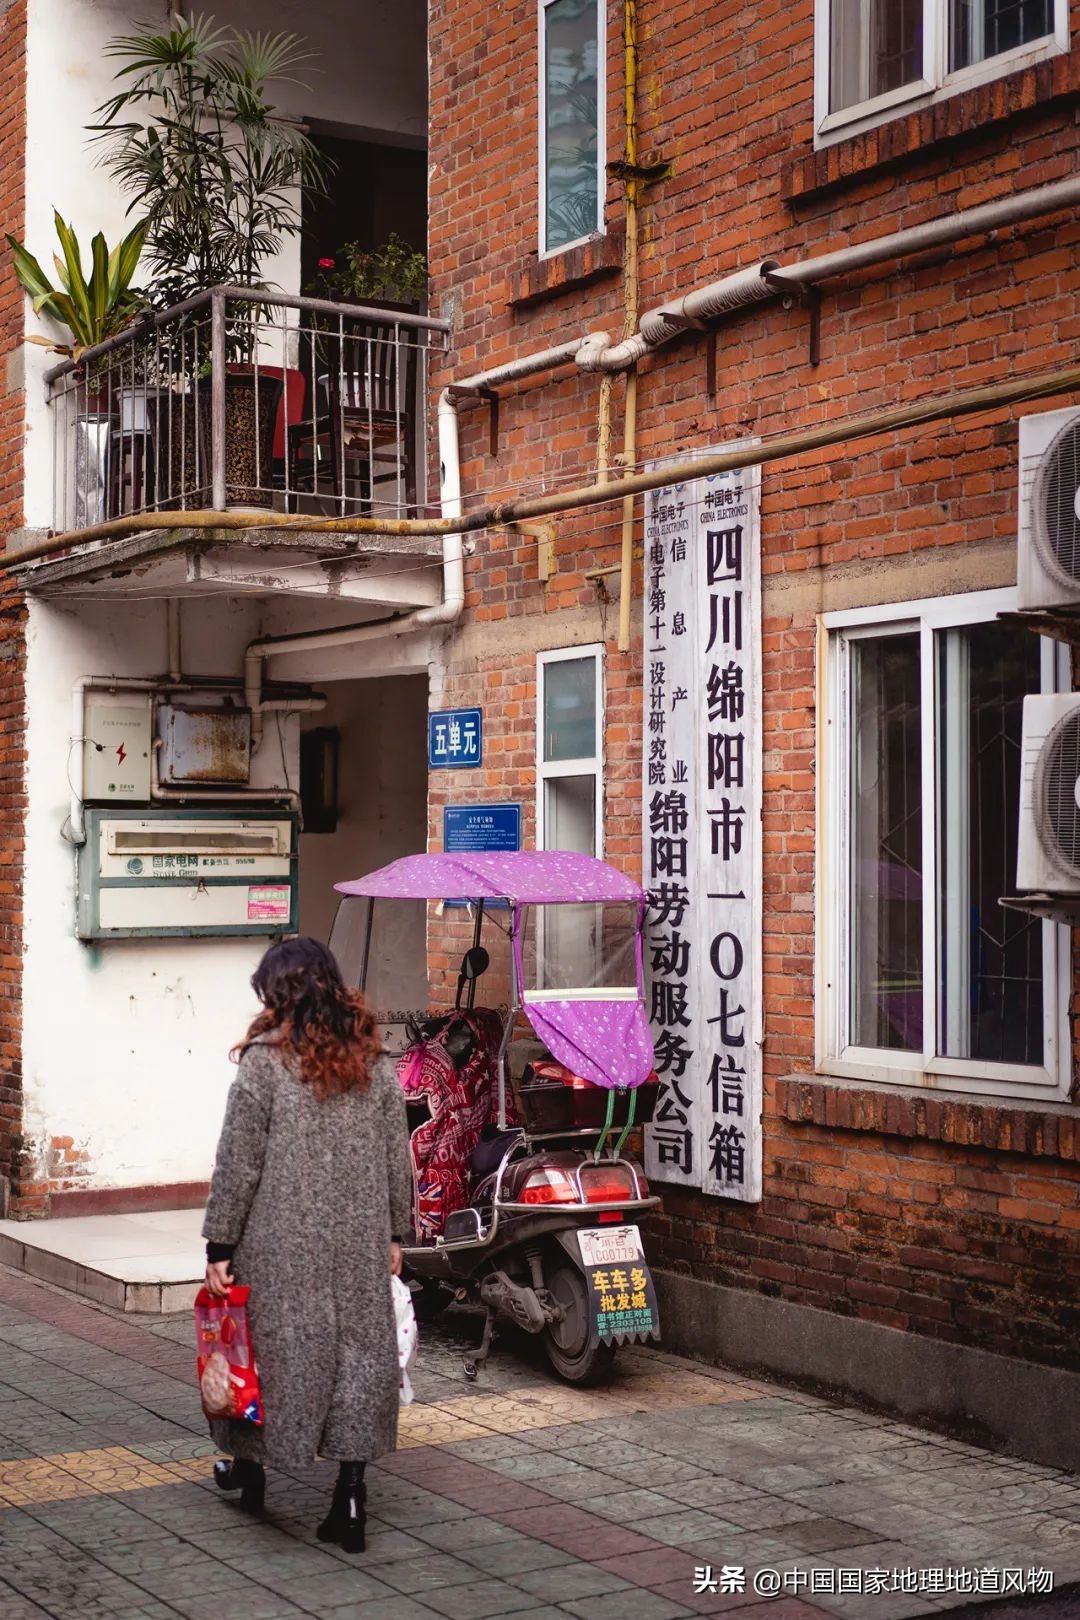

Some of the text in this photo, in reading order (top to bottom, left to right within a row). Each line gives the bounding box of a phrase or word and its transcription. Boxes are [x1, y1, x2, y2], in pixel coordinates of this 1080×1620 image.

[705, 485, 744, 509] 中国电子
[651, 502, 685, 524] 中国电子
[700, 504, 748, 524] CHINA ELECTRONICS
[647, 519, 689, 538] CHINA ELECTRONICS
[648, 540, 667, 785] 电子第十一设计研究院
[435, 721, 477, 756] 五单元
[153, 855, 199, 868] 国家电网
[649, 789, 694, 1175] 绵阳劳动服务公司
[592, 1267, 647, 1294] 车车多
[600, 1291, 647, 1312] 批发城
